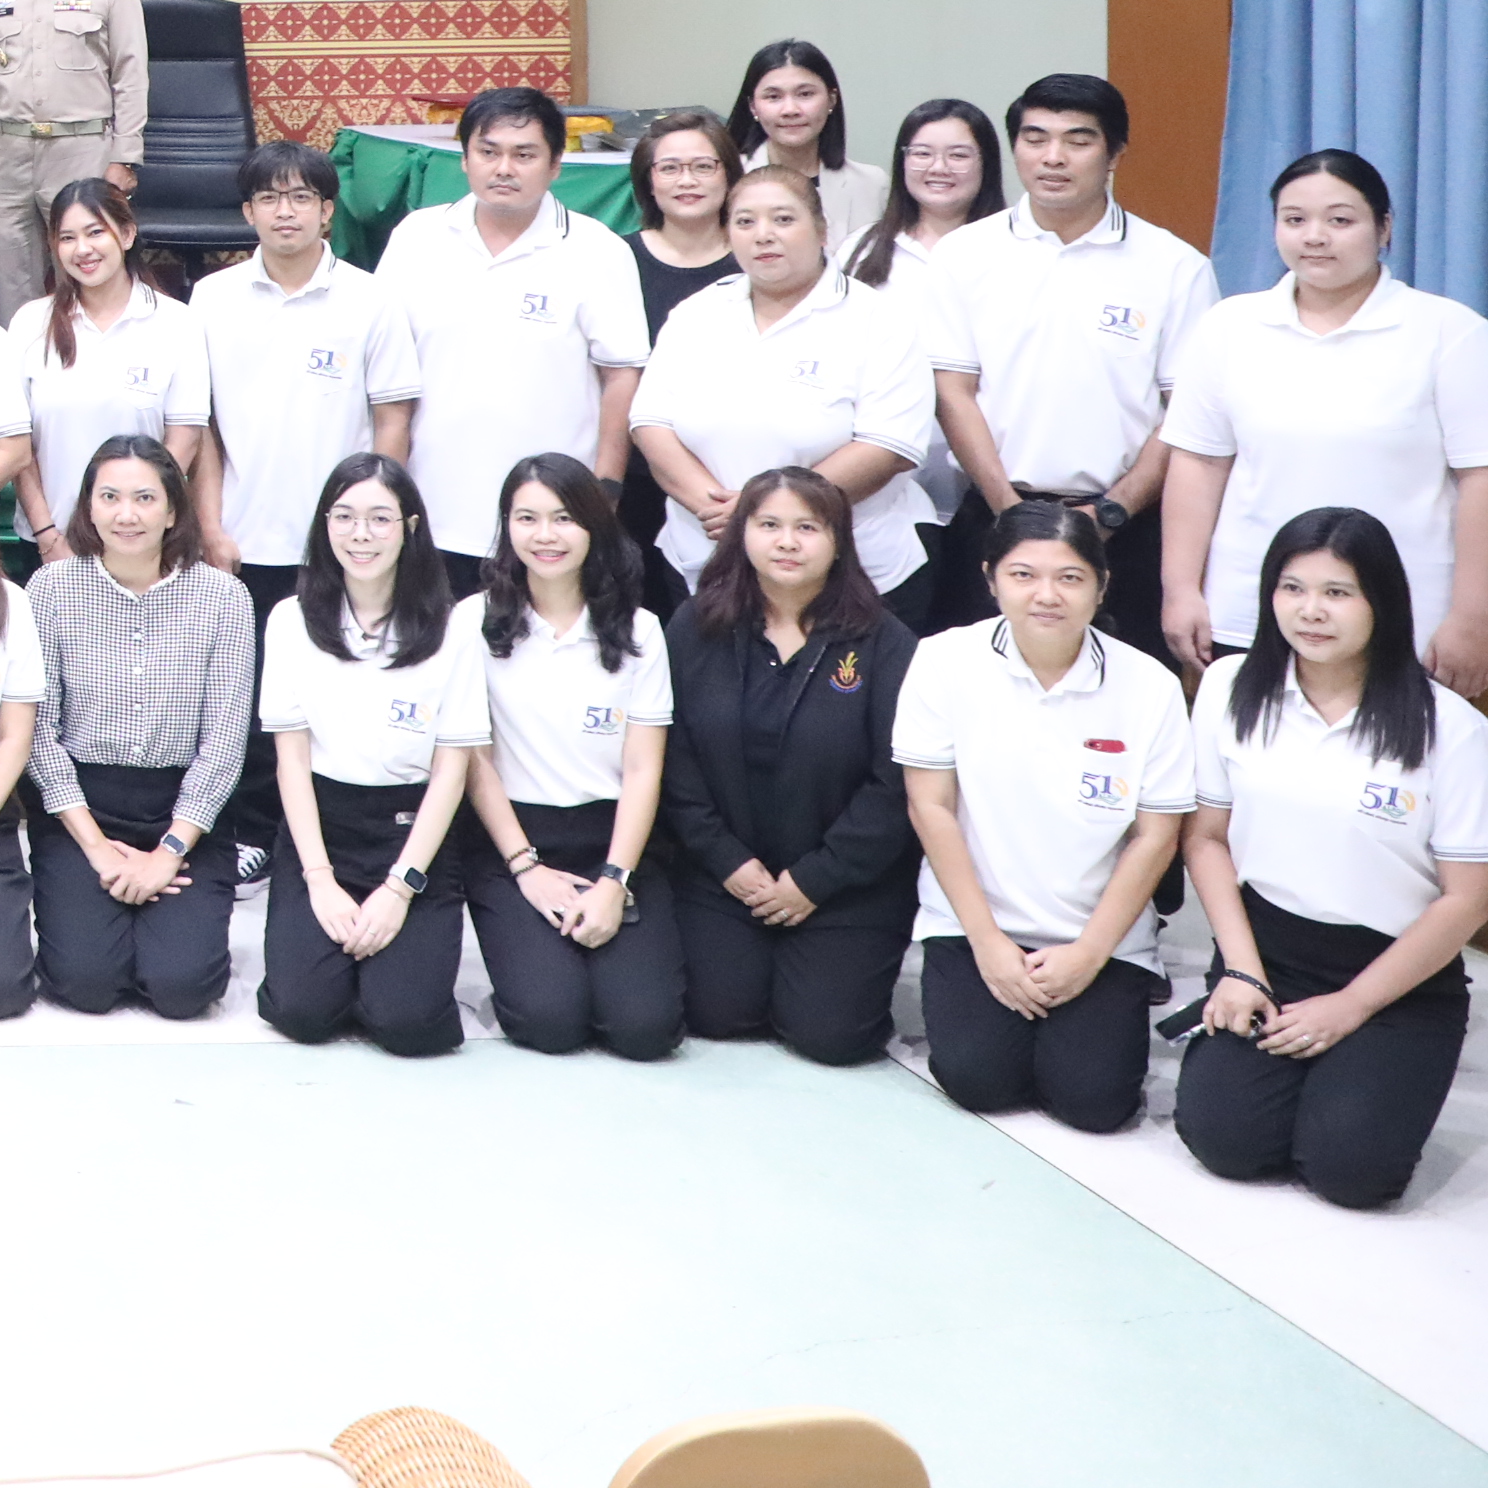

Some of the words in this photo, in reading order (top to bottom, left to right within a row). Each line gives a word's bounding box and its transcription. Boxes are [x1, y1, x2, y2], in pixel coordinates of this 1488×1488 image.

[520, 293, 548, 314] 51
[1099, 304, 1132, 327] 51
[307, 348, 335, 369] 51
[790, 360, 820, 379] 51
[125, 366, 149, 385] 51
[388, 699, 418, 722] 51
[583, 706, 612, 728] 51
[1078, 772, 1112, 799] 51
[1359, 781, 1400, 810] 51
